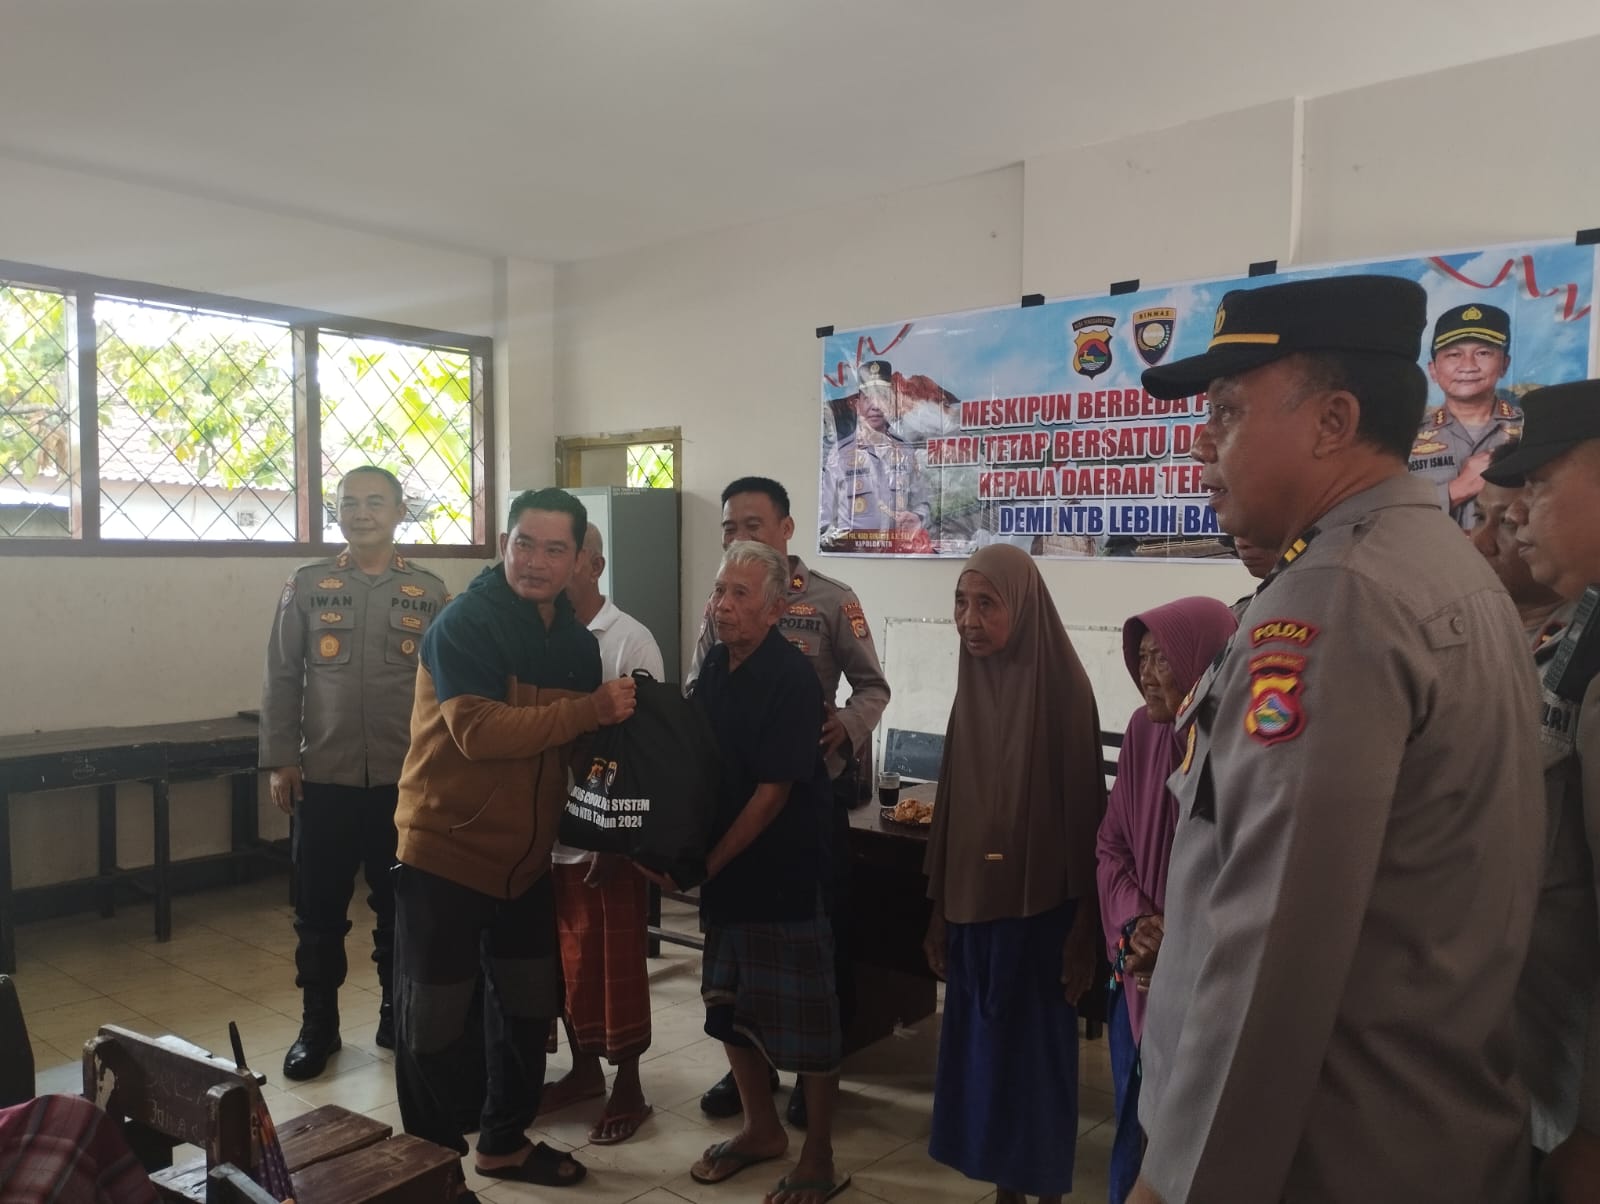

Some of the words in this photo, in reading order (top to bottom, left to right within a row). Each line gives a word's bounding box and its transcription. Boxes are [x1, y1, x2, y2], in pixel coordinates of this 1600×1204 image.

[1138, 310, 1170, 320] BINMAS
[961, 393, 1072, 427] MESKIPUN
[1077, 389, 1188, 419] BERBEDA
[927, 436, 980, 466] MARI
[984, 432, 1049, 463] TETAP
[1054, 426, 1167, 459] BERSATU
[979, 468, 1057, 497] KEPALA
[1061, 466, 1155, 496] DAERAH
[1000, 506, 1053, 533] DEMI
[1059, 506, 1104, 533] NTB
[1109, 505, 1177, 533] LEBIH
[1183, 505, 1221, 534] BA
[310, 595, 353, 608] IWAN
[391, 597, 433, 614] POLRI
[780, 617, 821, 631] POLRI
[1253, 622, 1309, 642] POLDA
[611, 798, 650, 812] SYSTEM
